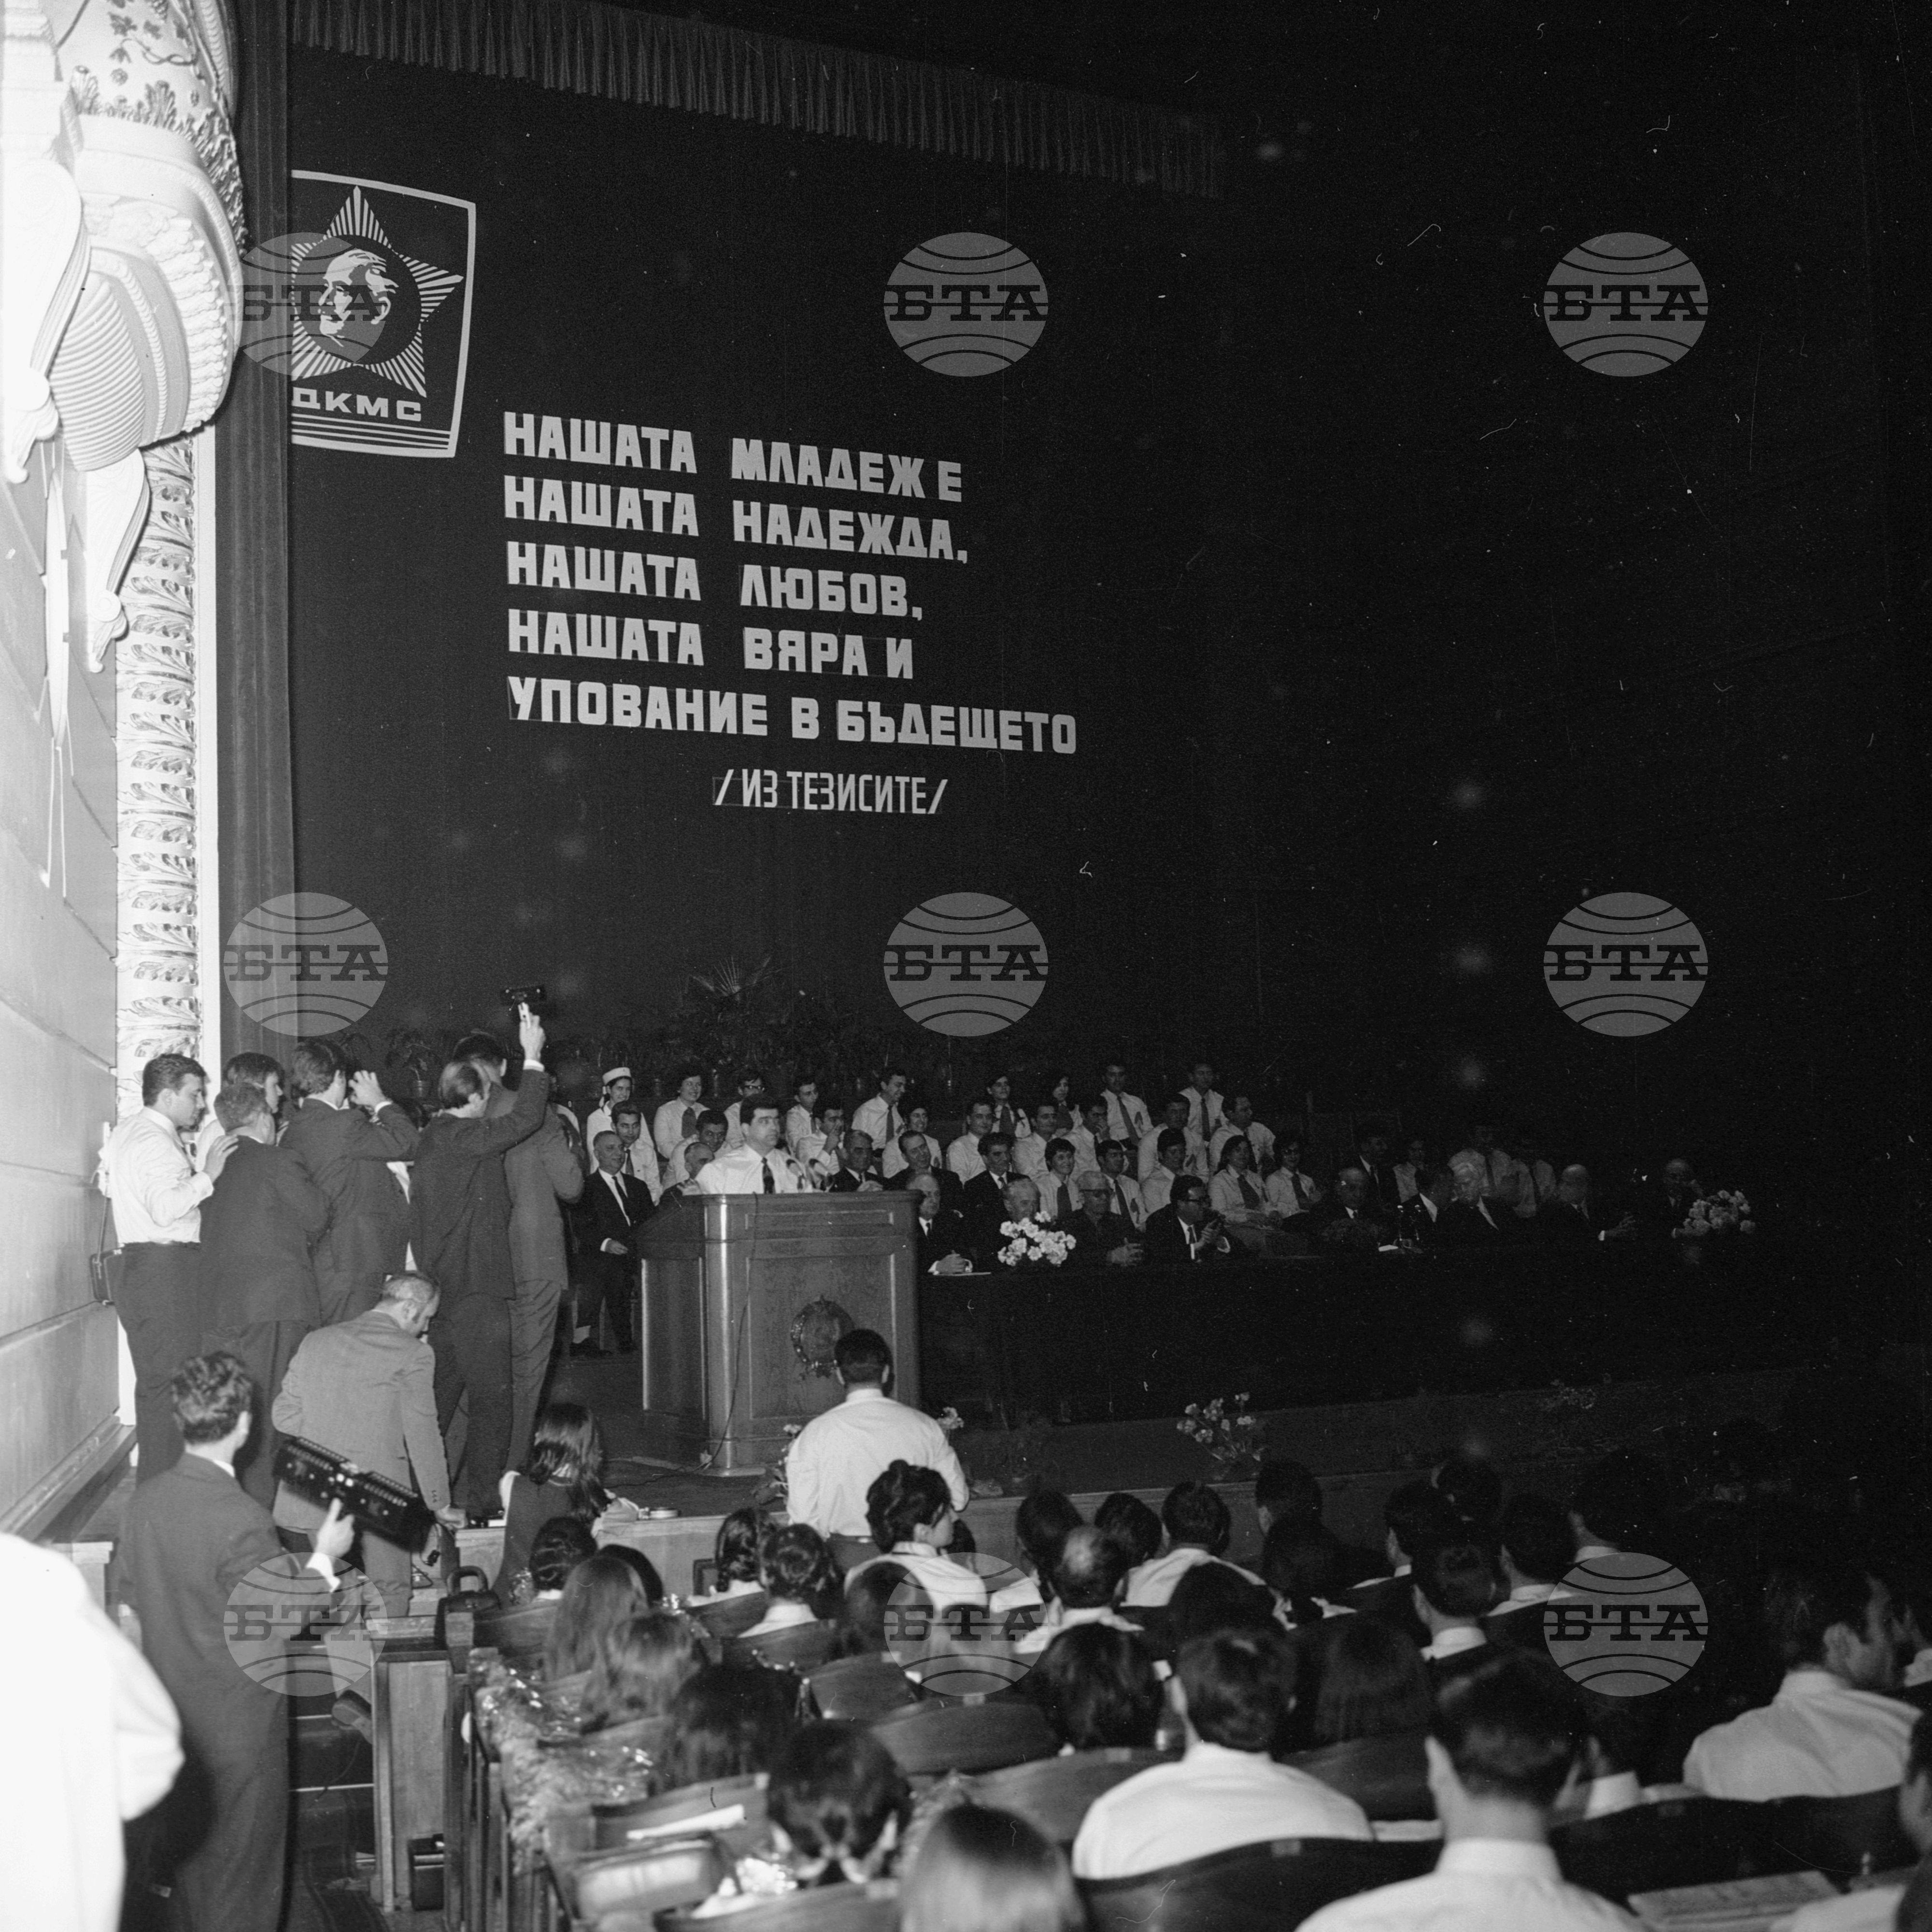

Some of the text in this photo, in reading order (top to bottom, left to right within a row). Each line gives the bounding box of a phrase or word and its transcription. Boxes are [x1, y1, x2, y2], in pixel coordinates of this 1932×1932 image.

[292, 387, 422, 422] ДКМС
[504, 412, 961, 501] НАШАТА МЛАДЕЖ Е
[504, 475, 967, 564] НАШАТА НАДЕЖДА,
[507, 541, 922, 620] НАШАТА ЛЮБОВ,
[509, 609, 912, 679] НАШАТА ВЯРА И
[508, 676, 1076, 753] УПОВАНИЕ В БЪДЕЩЕТО
